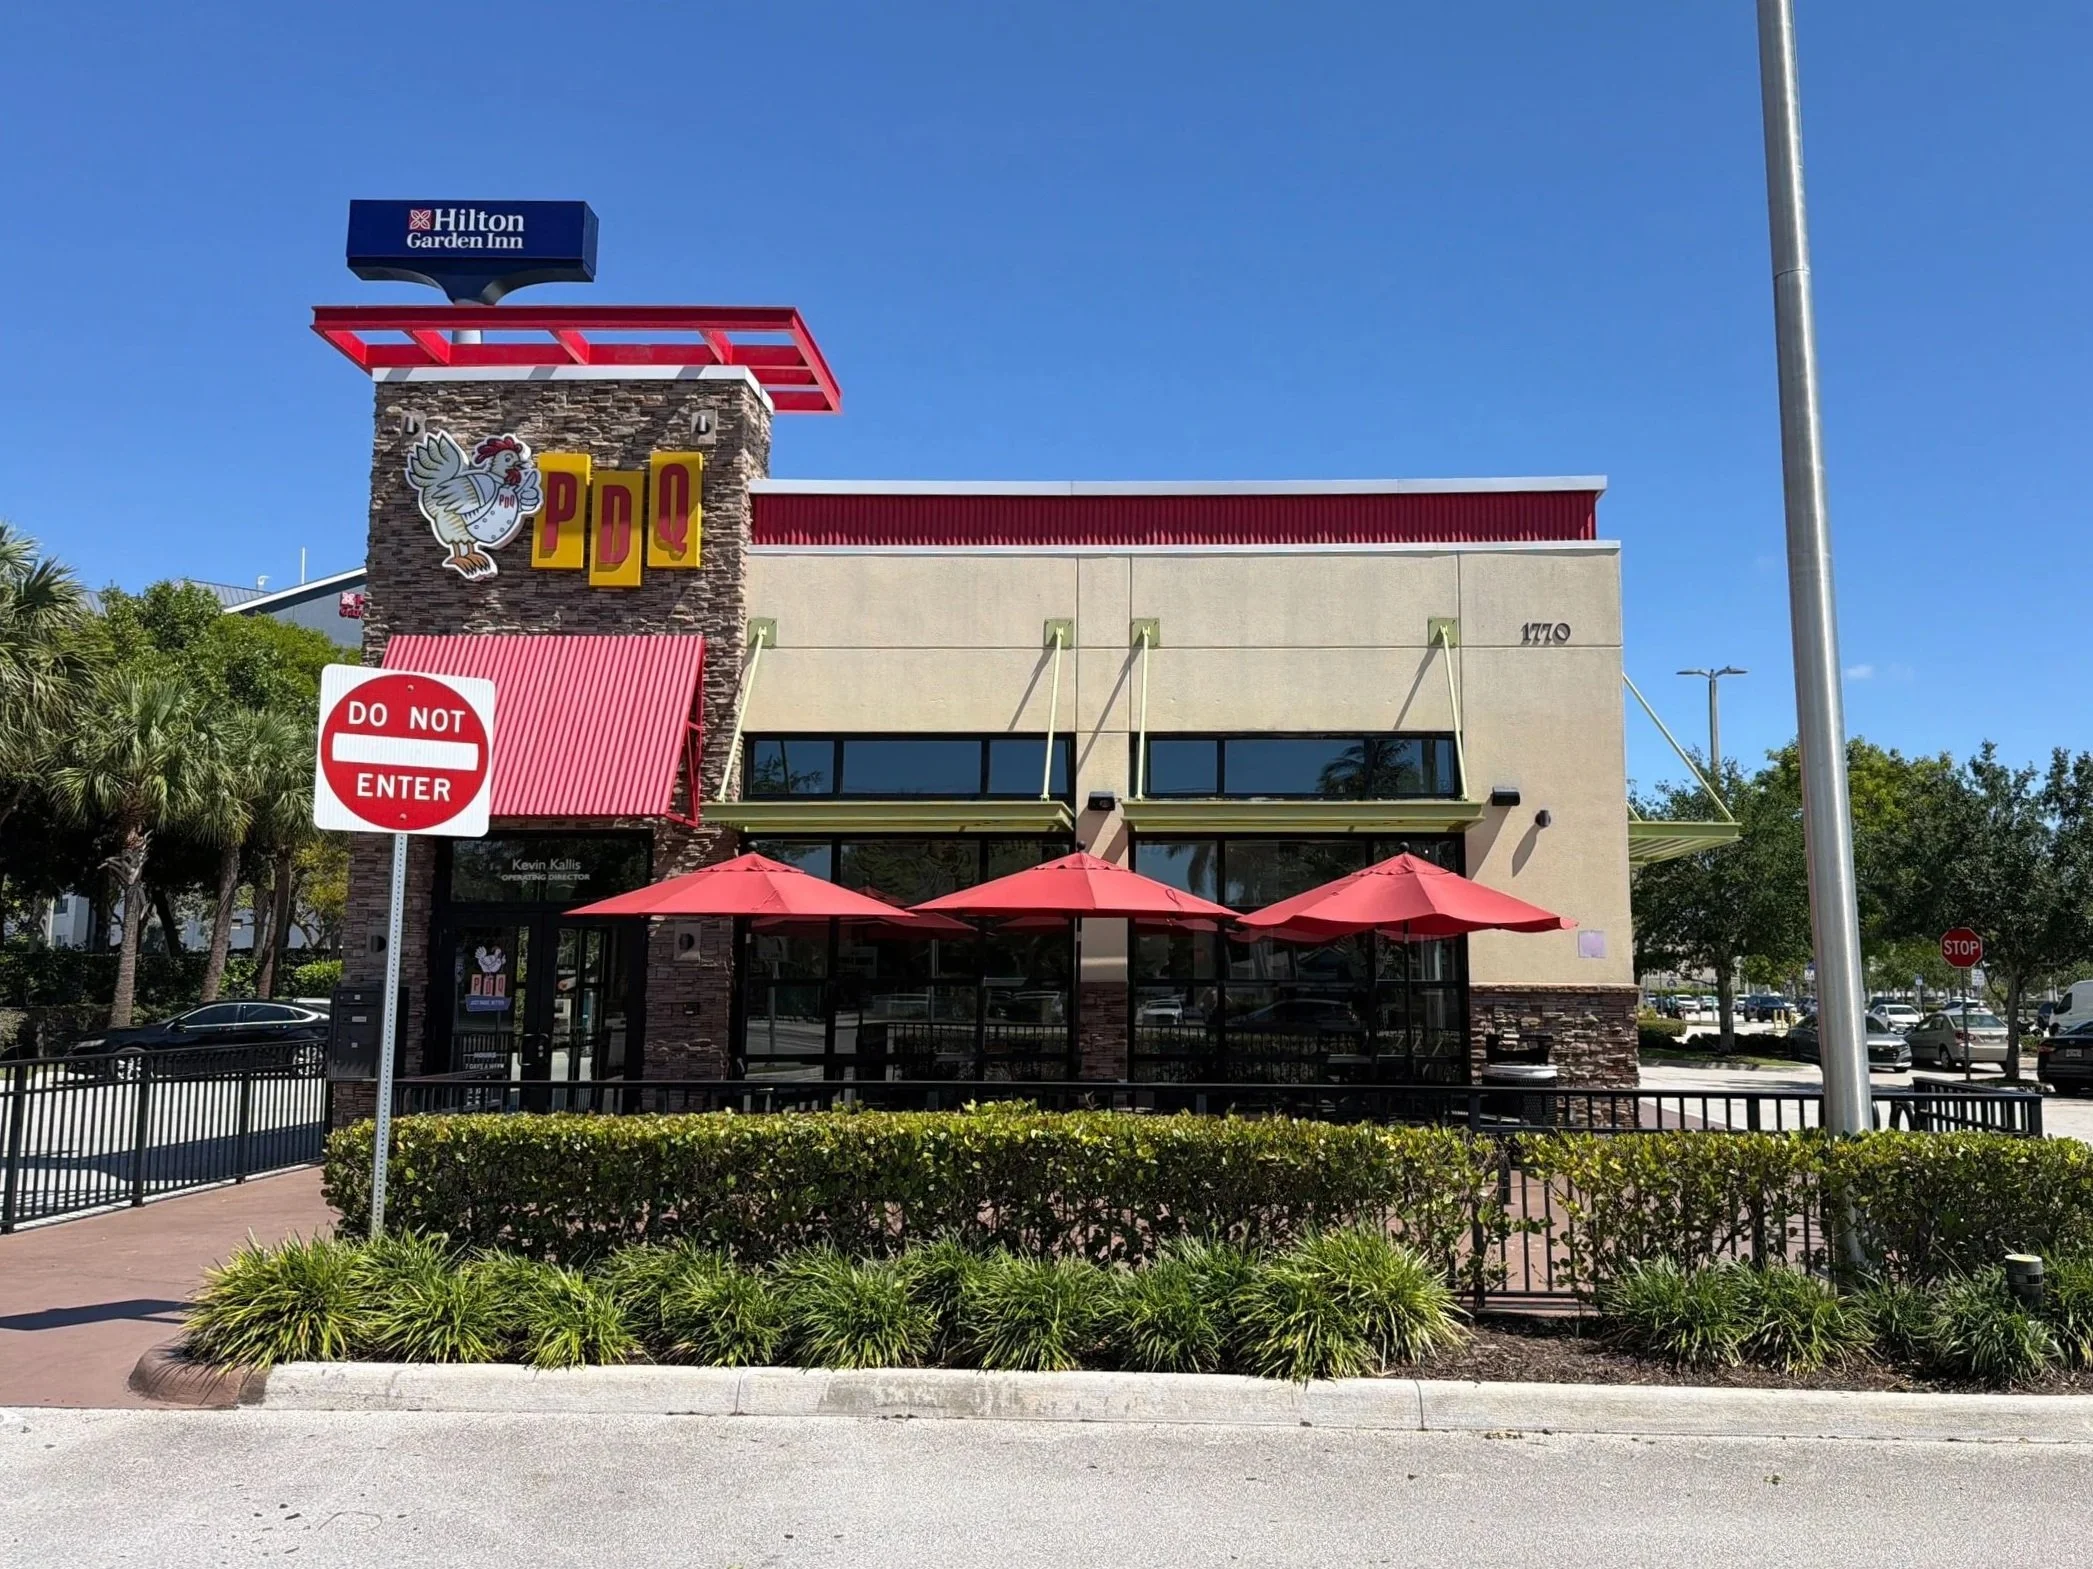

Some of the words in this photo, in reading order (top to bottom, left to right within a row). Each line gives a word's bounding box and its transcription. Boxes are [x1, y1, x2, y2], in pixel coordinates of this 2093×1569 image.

[433, 208, 525, 232] Hilton
[406, 232, 483, 249] Garden
[486, 232, 524, 249] Inn
[498, 494, 515, 509] PDQ
[543, 463, 690, 565] PDQ
[1520, 622, 1571, 642] 1770
[348, 701, 388, 727] DO
[409, 706, 466, 734] NOT
[357, 773, 451, 802] ENTER
[512, 859, 546, 871] Kevin
[550, 858, 581, 871] Kallis
[501, 873, 547, 881] OPERATING
[548, 873, 591, 881] DIRECTOR
[1943, 940, 1979, 956] STOP
[473, 977, 505, 995] PDQ
